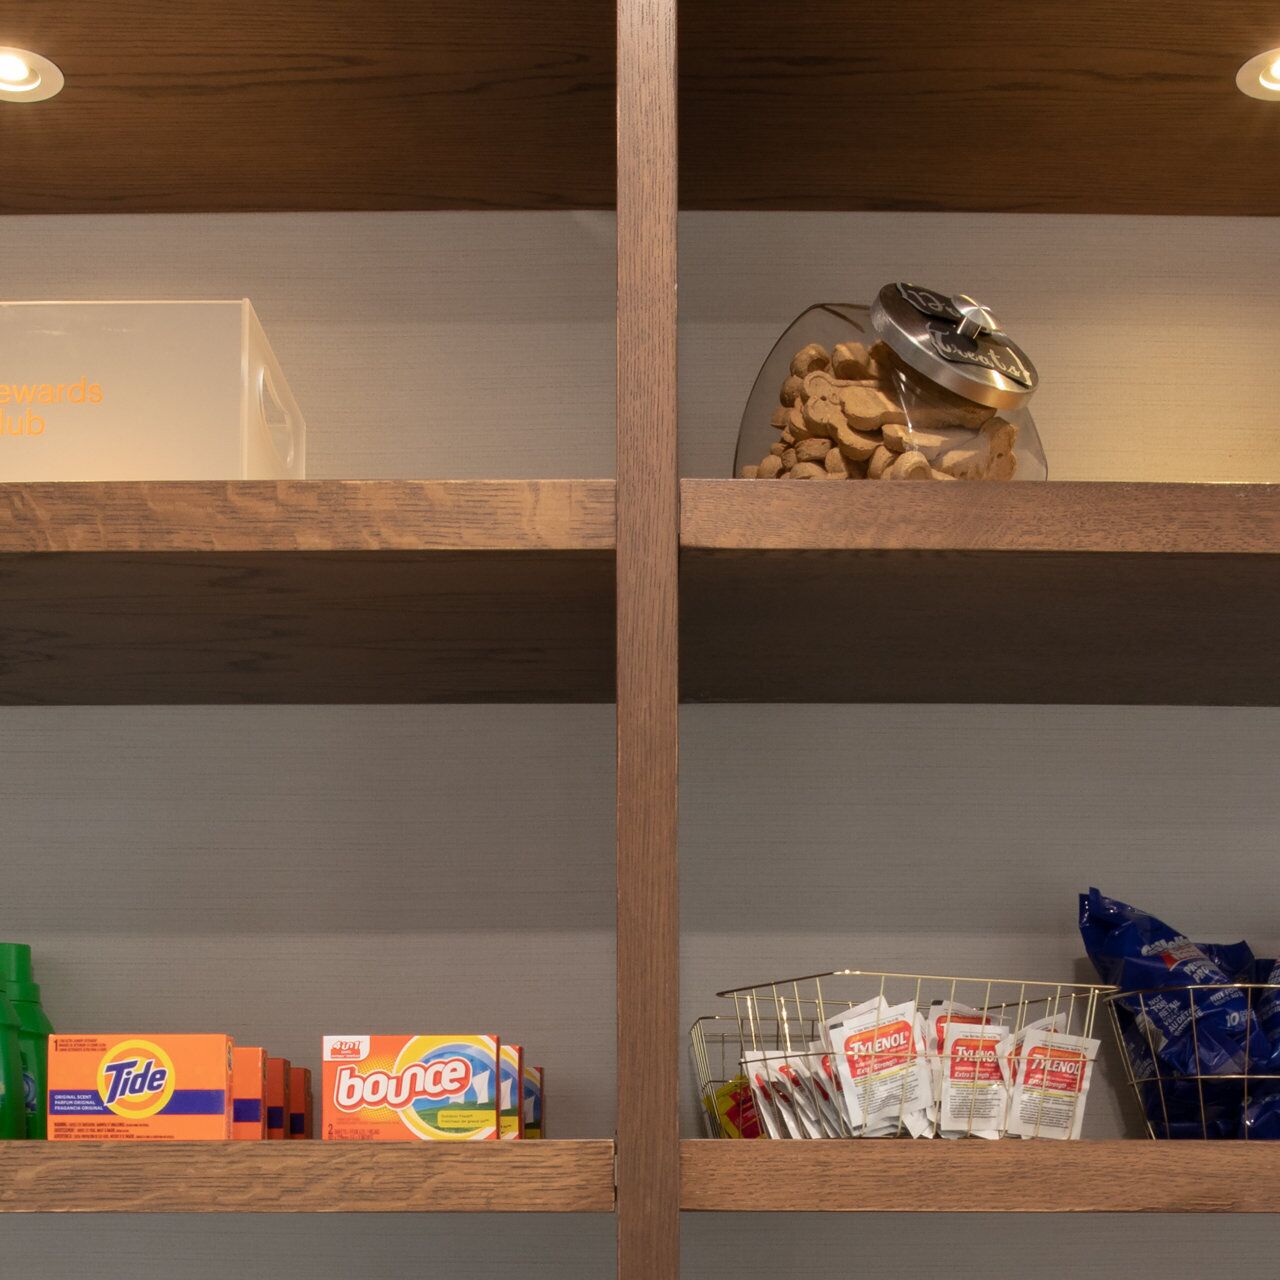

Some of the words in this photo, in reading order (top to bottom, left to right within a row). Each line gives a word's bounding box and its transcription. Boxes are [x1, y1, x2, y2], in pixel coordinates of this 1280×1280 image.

[850, 1033, 907, 1060] TYLENOL
[103, 1059, 167, 1106] Tide
[335, 1060, 468, 1107] bounce
[328, 1123, 333, 1134] 2
